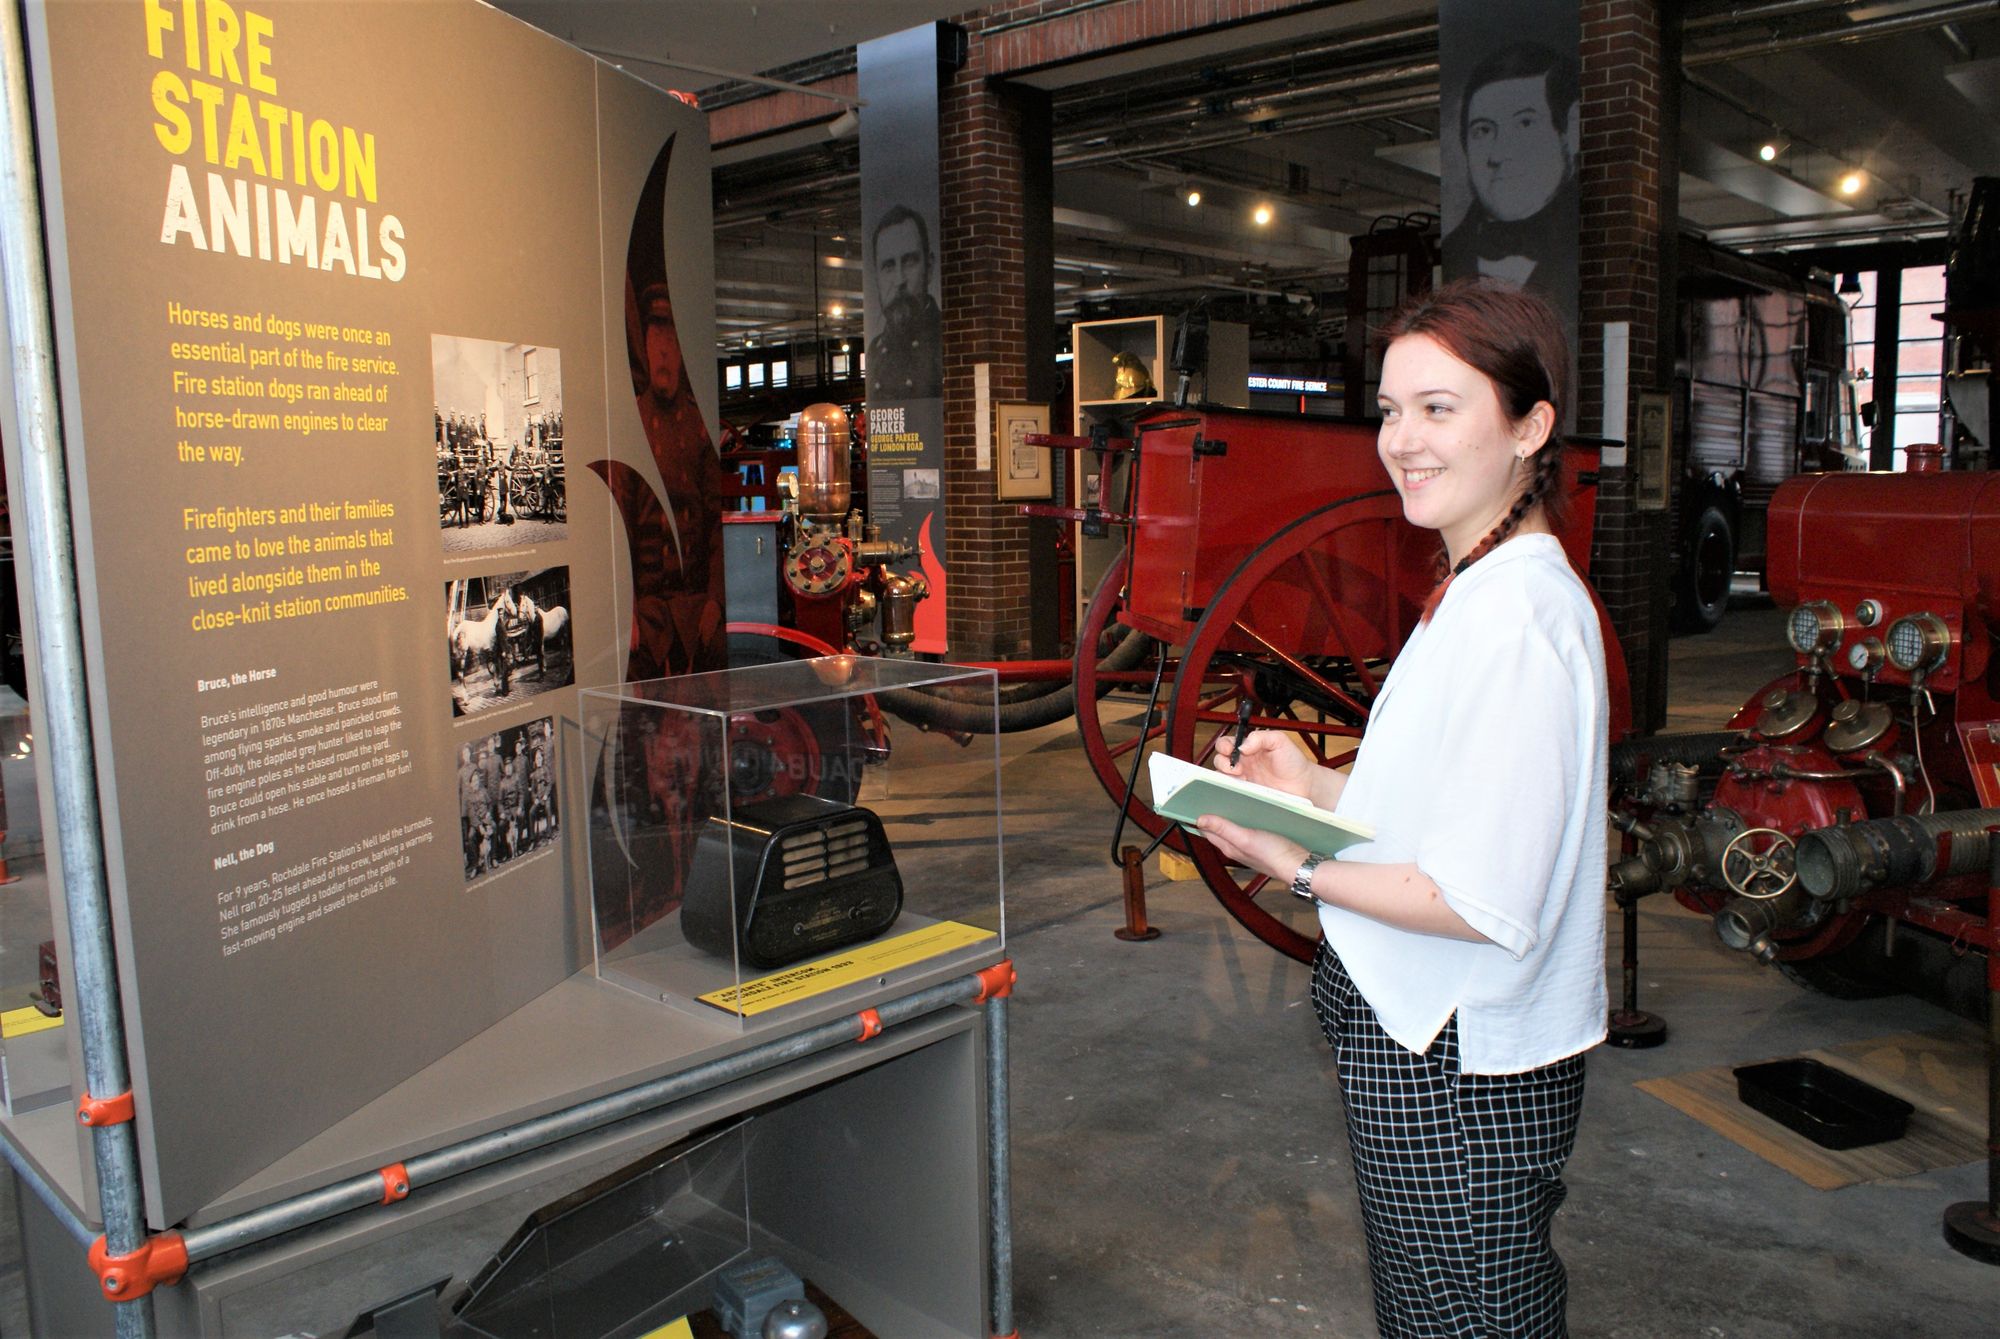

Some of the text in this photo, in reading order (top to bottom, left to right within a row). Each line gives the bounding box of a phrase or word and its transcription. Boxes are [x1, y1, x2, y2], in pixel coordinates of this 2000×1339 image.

[144, 0, 277, 96] FIRE
[151, 71, 377, 203] STATION
[160, 164, 407, 282] ANIMALS
[168, 302, 391, 346] Horses and dogs were once an
[170, 342, 399, 375] essential part of the fire service.
[173, 371, 387, 404] Fire station dogs ran ahead of
[175, 406, 387, 435] horse-drawn engines to clear
[870, 408, 905, 422] GEORGE
[870, 421, 905, 434] PARKER
[178, 440, 244, 466] the way.
[871, 432, 919, 443] GEORGE PARKER
[871, 441, 924, 452] OF LONDON ROAD
[183, 499, 394, 533] Firefighters and their families
[186, 528, 393, 564] came to love the animals that
[189, 558, 380, 597] lived alongside them in the
[192, 584, 409, 632] close-knit station communities.
[197, 668, 276, 692] Bruce, the Horse
[238, 701, 289, 719] intelligence
[290, 694, 306, 708] and
[307, 689, 327, 707] good
[328, 684, 358, 699] humour
[359, 680, 378, 691] were
[202, 727, 248, 747] legendary
[250, 723, 259, 734] in
[261, 716, 286, 731] 1870s
[337, 700, 361, 713] Bruce
[361, 693, 382, 707] stood
[204, 748, 236, 764] among
[238, 741, 262, 757] flying
[297, 724, 324, 740] smoke
[325, 719, 340, 733] and
[341, 710, 374, 731] panicked
[207, 787, 224, 799] fire
[225, 778, 256, 794] engine
[258, 771, 282, 788] poles
[283, 767, 294, 778] as
[294, 763, 306, 774] he
[306, 753, 335, 771] chased
[336, 746, 359, 762] round
[247, 758, 262, 770] the
[263, 746, 297, 766] dappled
[299, 744, 316, 759] grey
[318, 736, 343, 751] hunter
[209, 761, 371, 818] Bruce could open his stable and turn on
[210, 818, 235, 835] drink
[237, 812, 259, 826] from
[260, 810, 266, 819] a
[292, 796, 304, 809] He
[306, 791, 325, 804] once
[326, 781, 350, 798] hosed
[357, 772, 386, 788] fireman
[398, 761, 412, 774] fun!
[214, 842, 274, 870] Nell, the Dog
[217, 891, 233, 905] For
[235, 886, 241, 898] 9
[271, 862, 310, 884] Rochdale
[311, 856, 327, 869] Fire
[362, 835, 378, 849] Nell
[391, 828, 403, 838] the
[219, 904, 239, 922] Nell
[241, 901, 256, 914] ran
[258, 887, 283, 907] 20-25
[284, 882, 301, 896] feet
[302, 871, 327, 890] ahead
[328, 867, 336, 879] of
[337, 864, 350, 876] the
[371, 845, 399, 862] barking
[221, 860, 396, 940] She famously tugged a toddler from path
[222, 928, 276, 957] fast-moving
[277, 915, 305, 933] engine
[307, 905, 322, 921] and
[323, 895, 346, 914] saved
[346, 892, 359, 904] the
